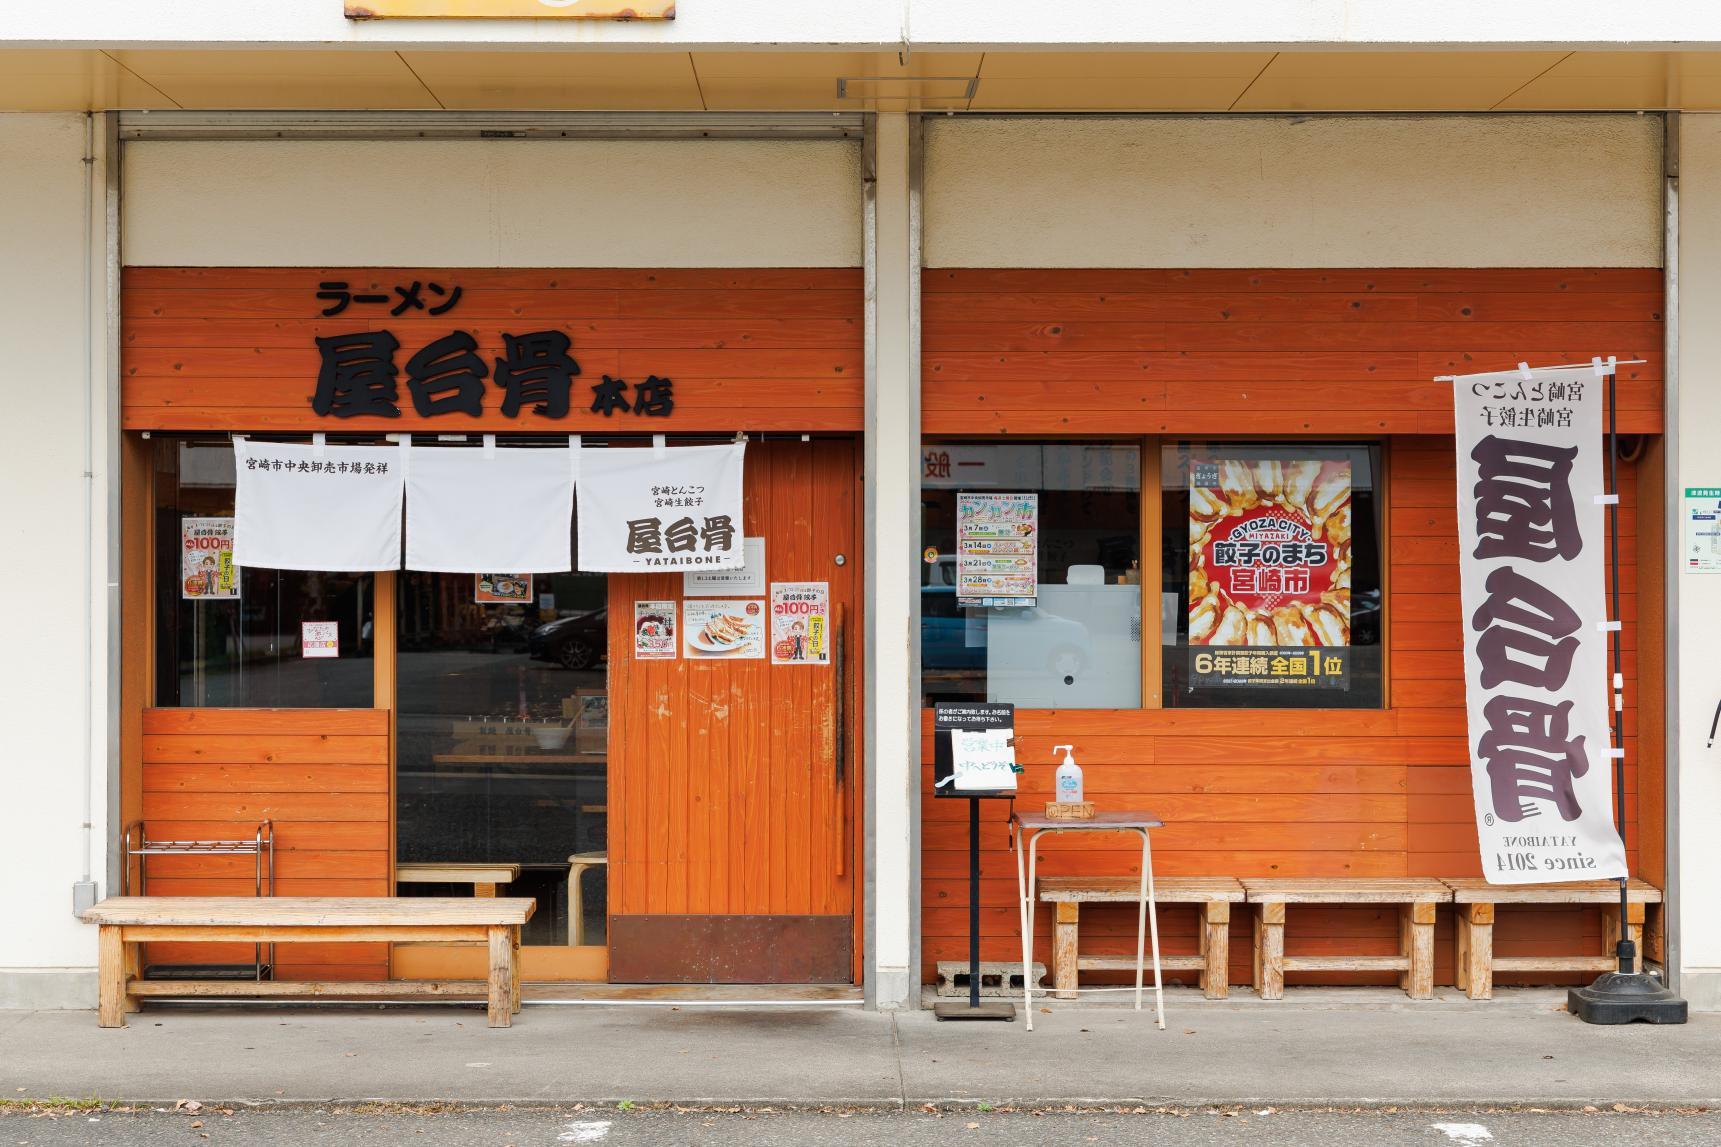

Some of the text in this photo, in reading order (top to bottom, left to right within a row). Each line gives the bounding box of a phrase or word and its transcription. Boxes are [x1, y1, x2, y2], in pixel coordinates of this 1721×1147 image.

[317, 282, 462, 316] ラーメン
[313, 330, 673, 420] 屋台骨 本店
[246, 457, 389, 474] 宮崎市中央卸売市場発祥
[651, 484, 705, 496] 宮崎とんこつ
[654, 496, 704, 508] 宮崎生餃子
[626, 515, 735, 554] 屋台骨
[1232, 517, 1310, 540] GYOZA CITY
[1249, 532, 1290, 540] MIYAZAKI
[645, 555, 721, 567] YATAIBONE
[1214, 542, 1327, 567] 餃子のまち
[1230, 568, 1310, 594] 宮崎市
[1195, 650, 1343, 676] 6年連続 全国1位
